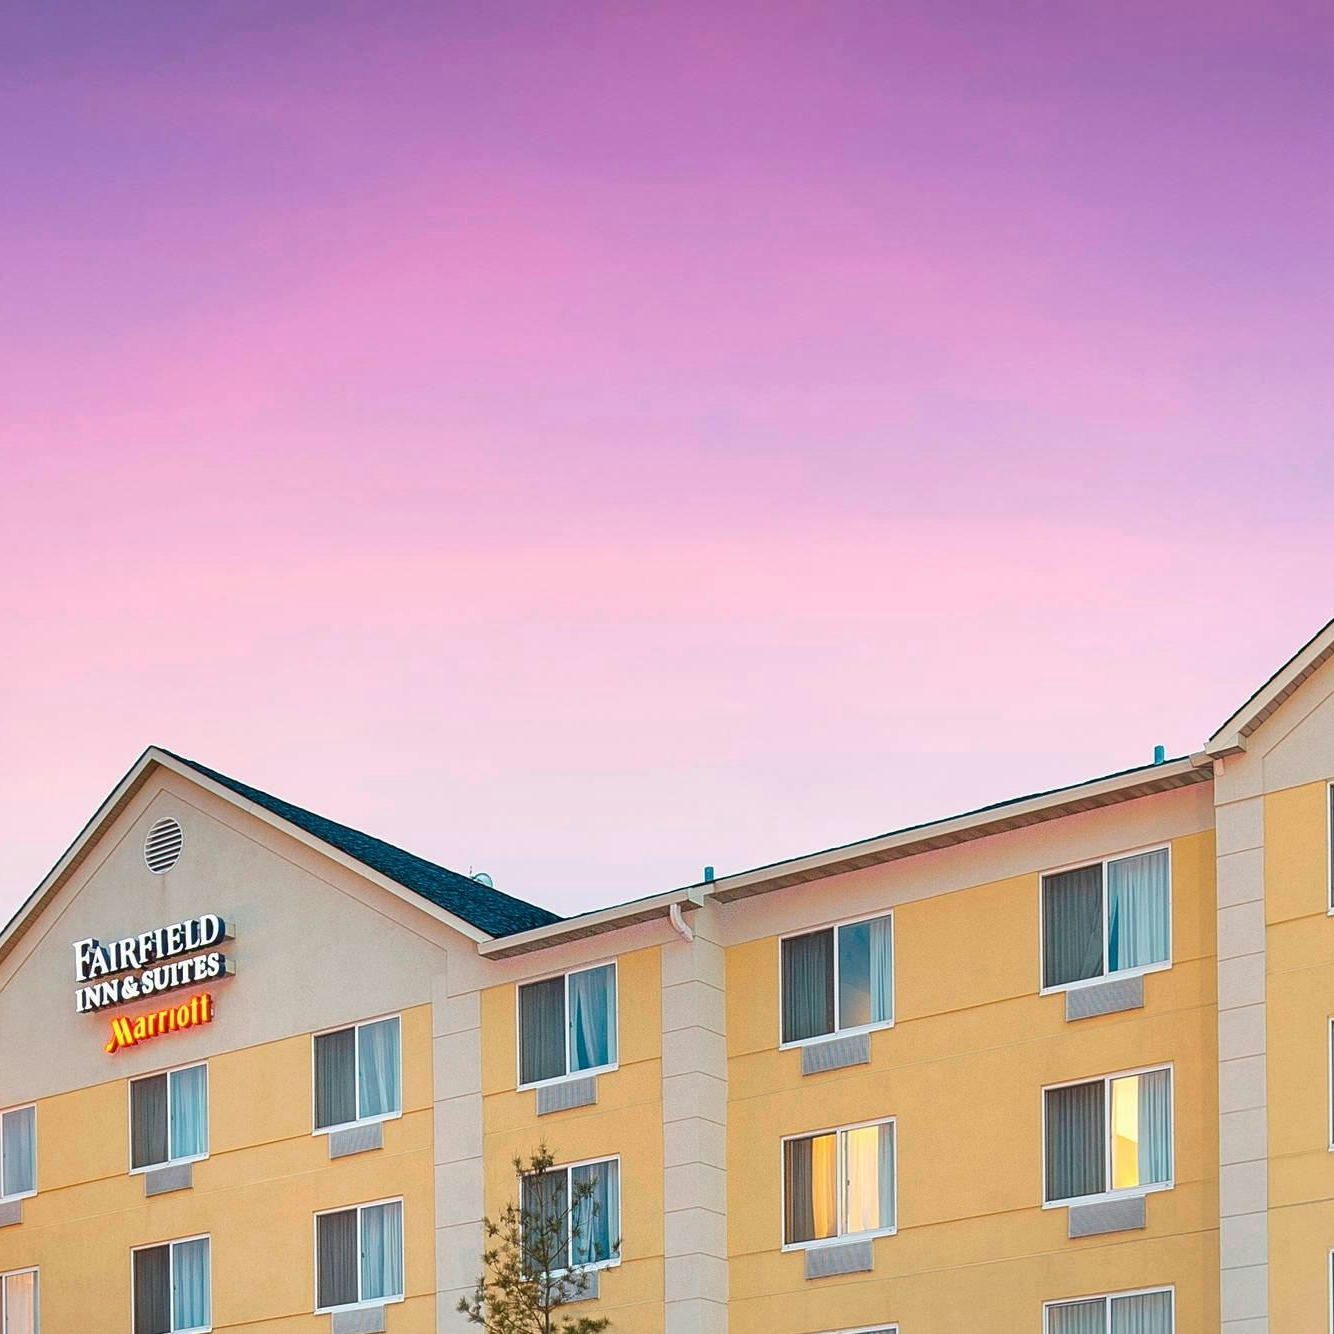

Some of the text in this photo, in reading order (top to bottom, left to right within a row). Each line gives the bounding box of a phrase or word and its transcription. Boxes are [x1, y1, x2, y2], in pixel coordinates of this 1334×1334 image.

[72, 914, 226, 983] FAIRFIELD
[75, 952, 226, 1014] INN & SUITES
[104, 993, 214, 1053] Marriott
